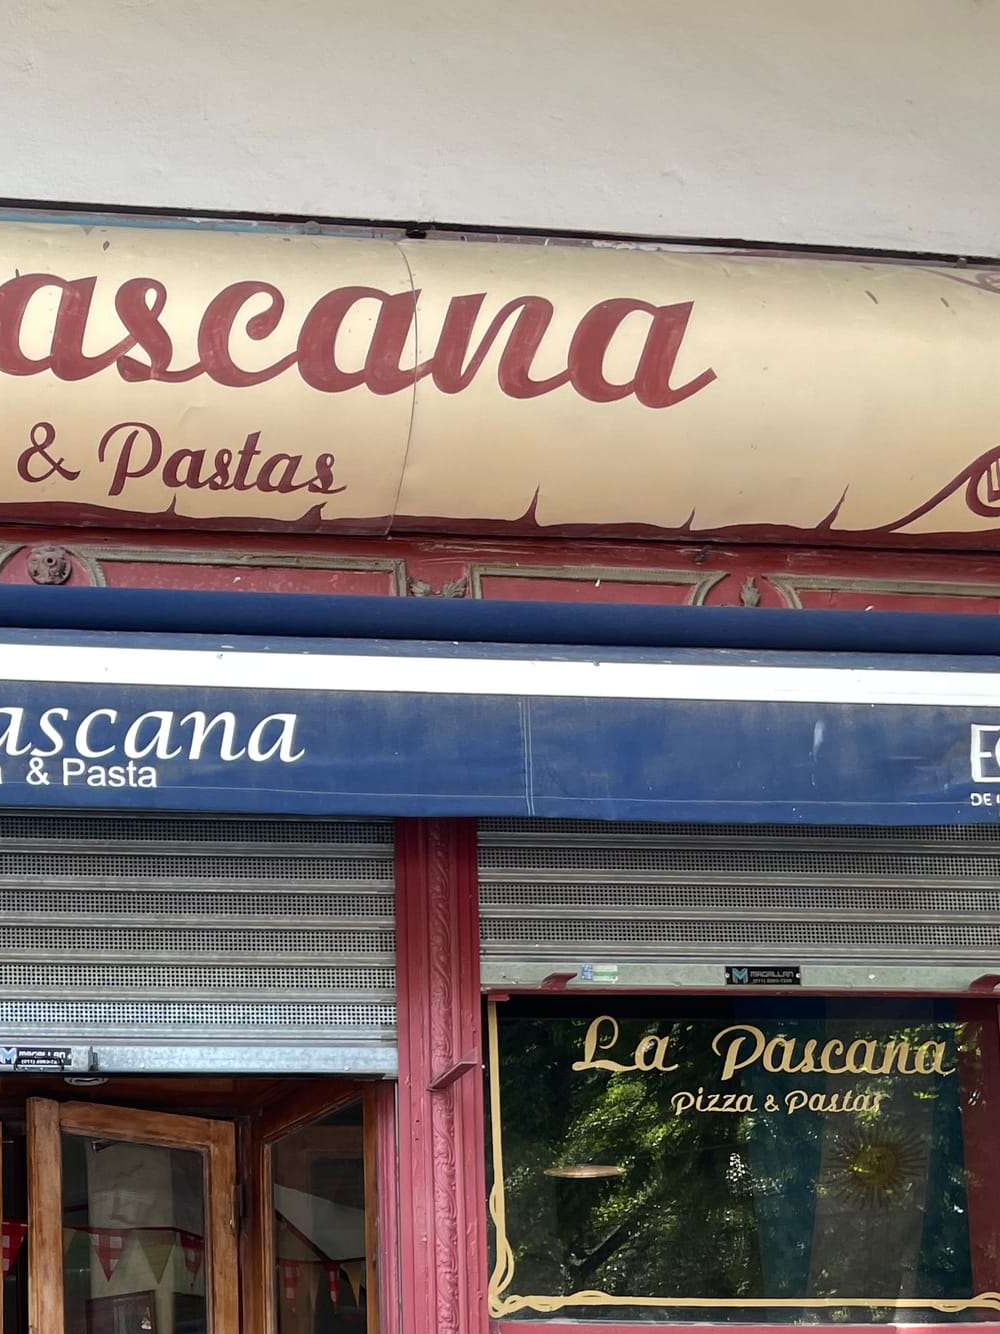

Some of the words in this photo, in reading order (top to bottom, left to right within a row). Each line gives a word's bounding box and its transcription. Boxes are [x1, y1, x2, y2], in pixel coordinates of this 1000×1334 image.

[17, 421, 80, 483] &
[99, 422, 347, 497] Pastas
[25, 757, 50, 786] &
[63, 757, 158, 789] Pasta
[970, 793, 992, 806] DE
[572, 1014, 679, 1073] La
[711, 1024, 957, 1081] Pascana
[670, 1086, 758, 1116] Pizza
[765, 1095, 780, 1112] &
[785, 1089, 882, 1115] Pastas
